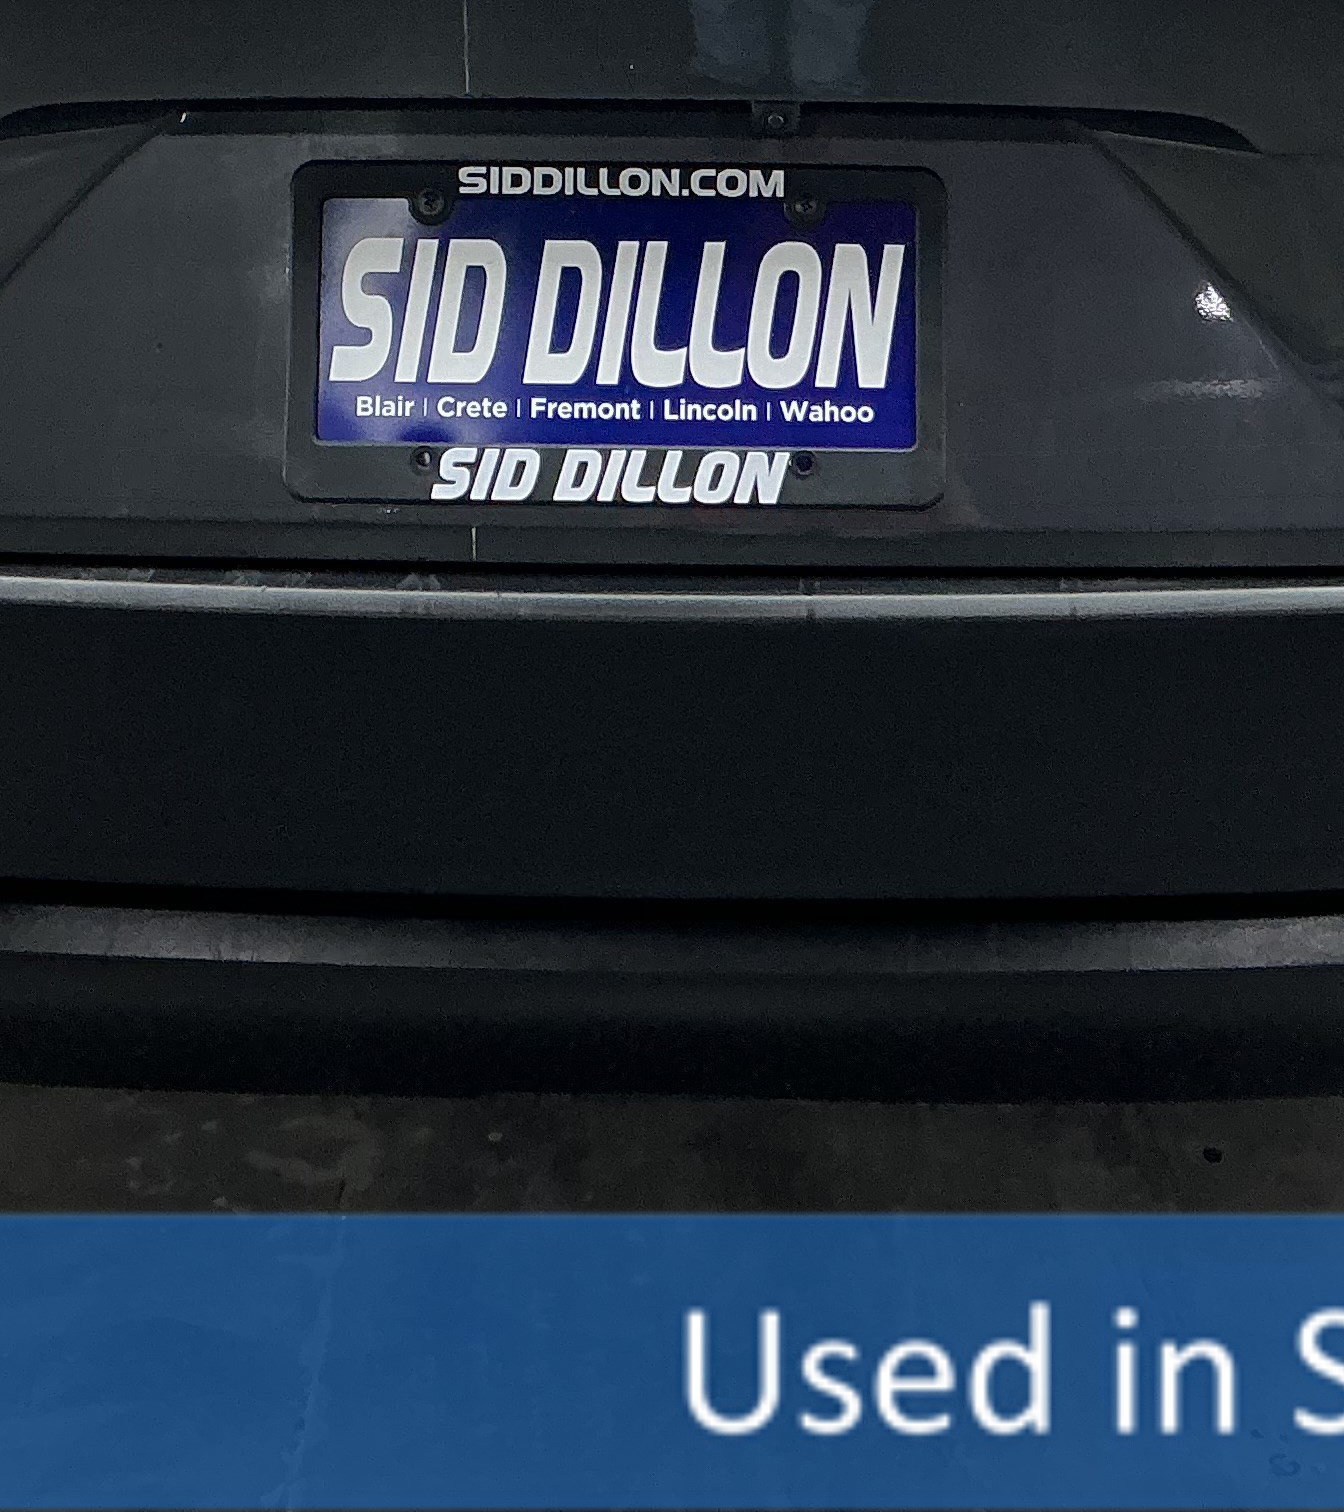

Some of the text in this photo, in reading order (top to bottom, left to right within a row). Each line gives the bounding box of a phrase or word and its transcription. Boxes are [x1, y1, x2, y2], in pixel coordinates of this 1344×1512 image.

[457, 165, 785, 198] SIDDILLON.COM
[328, 237, 905, 389] SID DILLON
[356, 394, 875, 424] Blair Crete Fremont Lincoln Wahoo
[430, 447, 791, 505] SID DILLON
